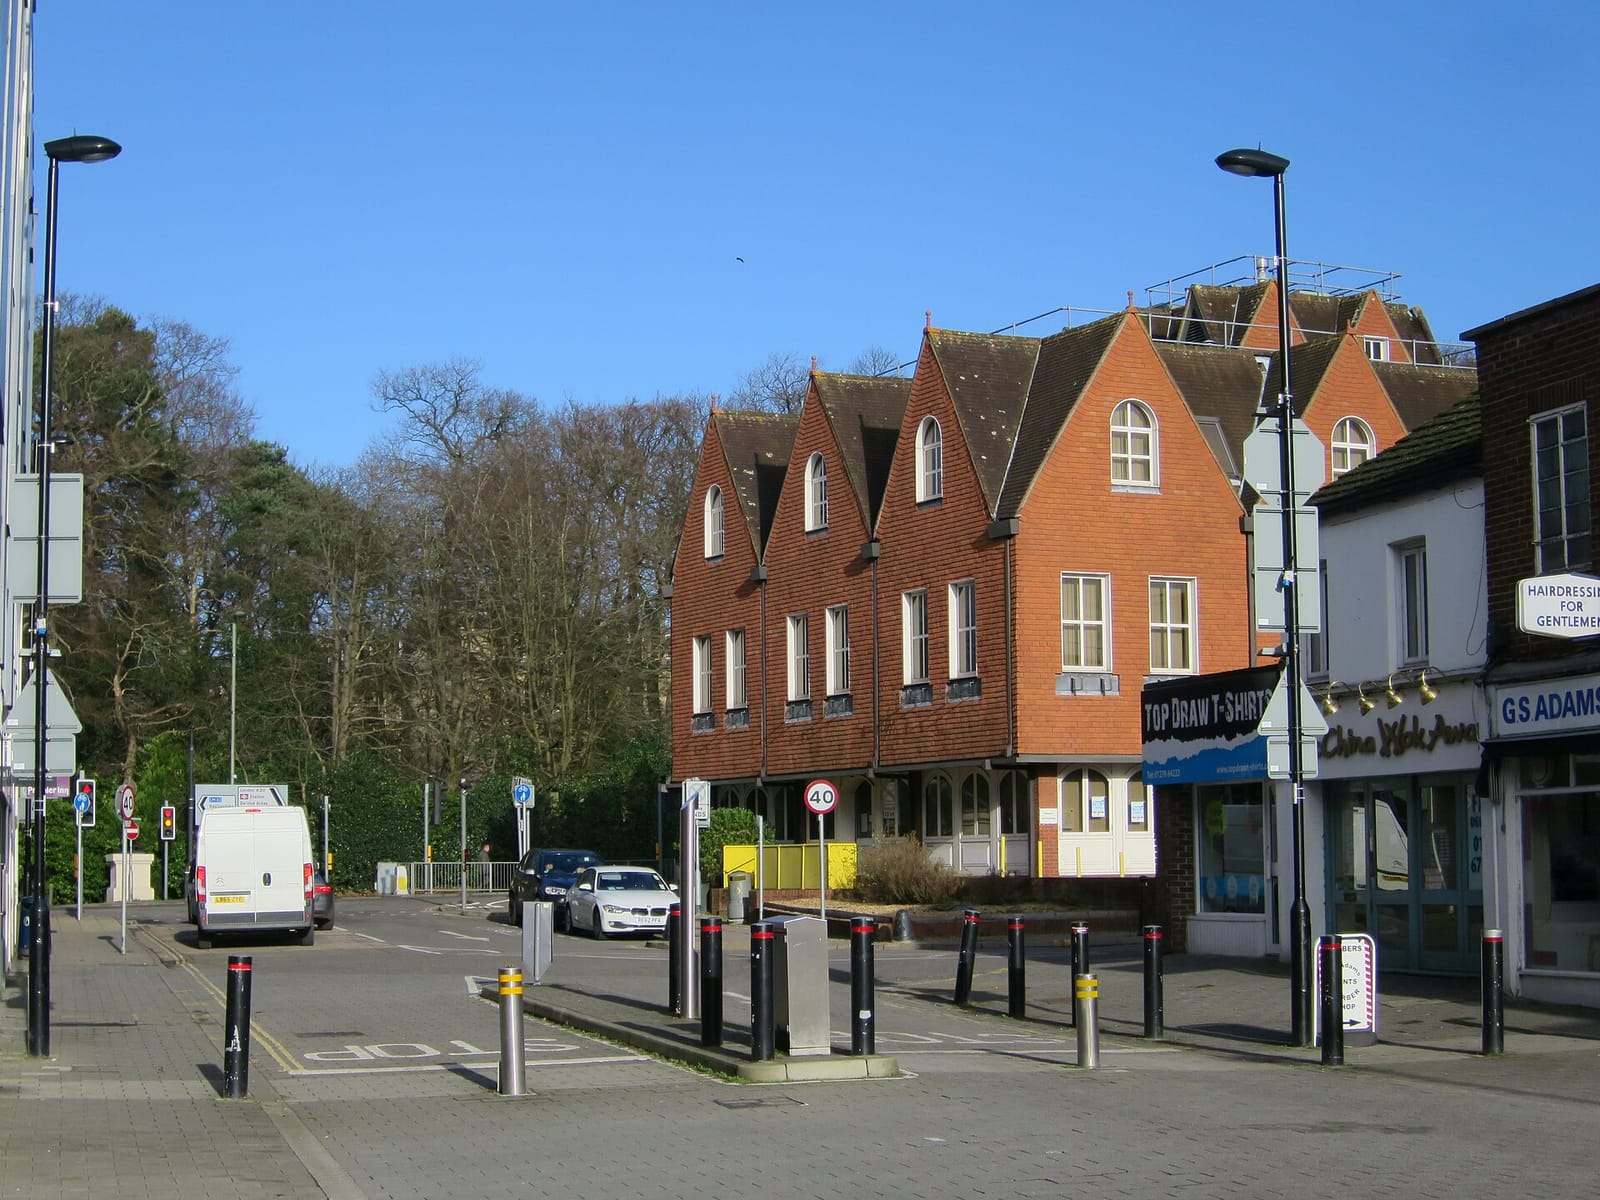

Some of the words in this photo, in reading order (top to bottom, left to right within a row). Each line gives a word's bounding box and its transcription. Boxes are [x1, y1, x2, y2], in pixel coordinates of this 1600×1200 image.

[1560, 601, 1583, 612] FOR
[1145, 703, 1169, 732] TOP
[1171, 697, 1208, 729] DRAW
[1321, 724, 1376, 758] China
[1377, 713, 1425, 757] Wok
[123, 796, 133, 809] 40
[810, 790, 833, 804] 40
